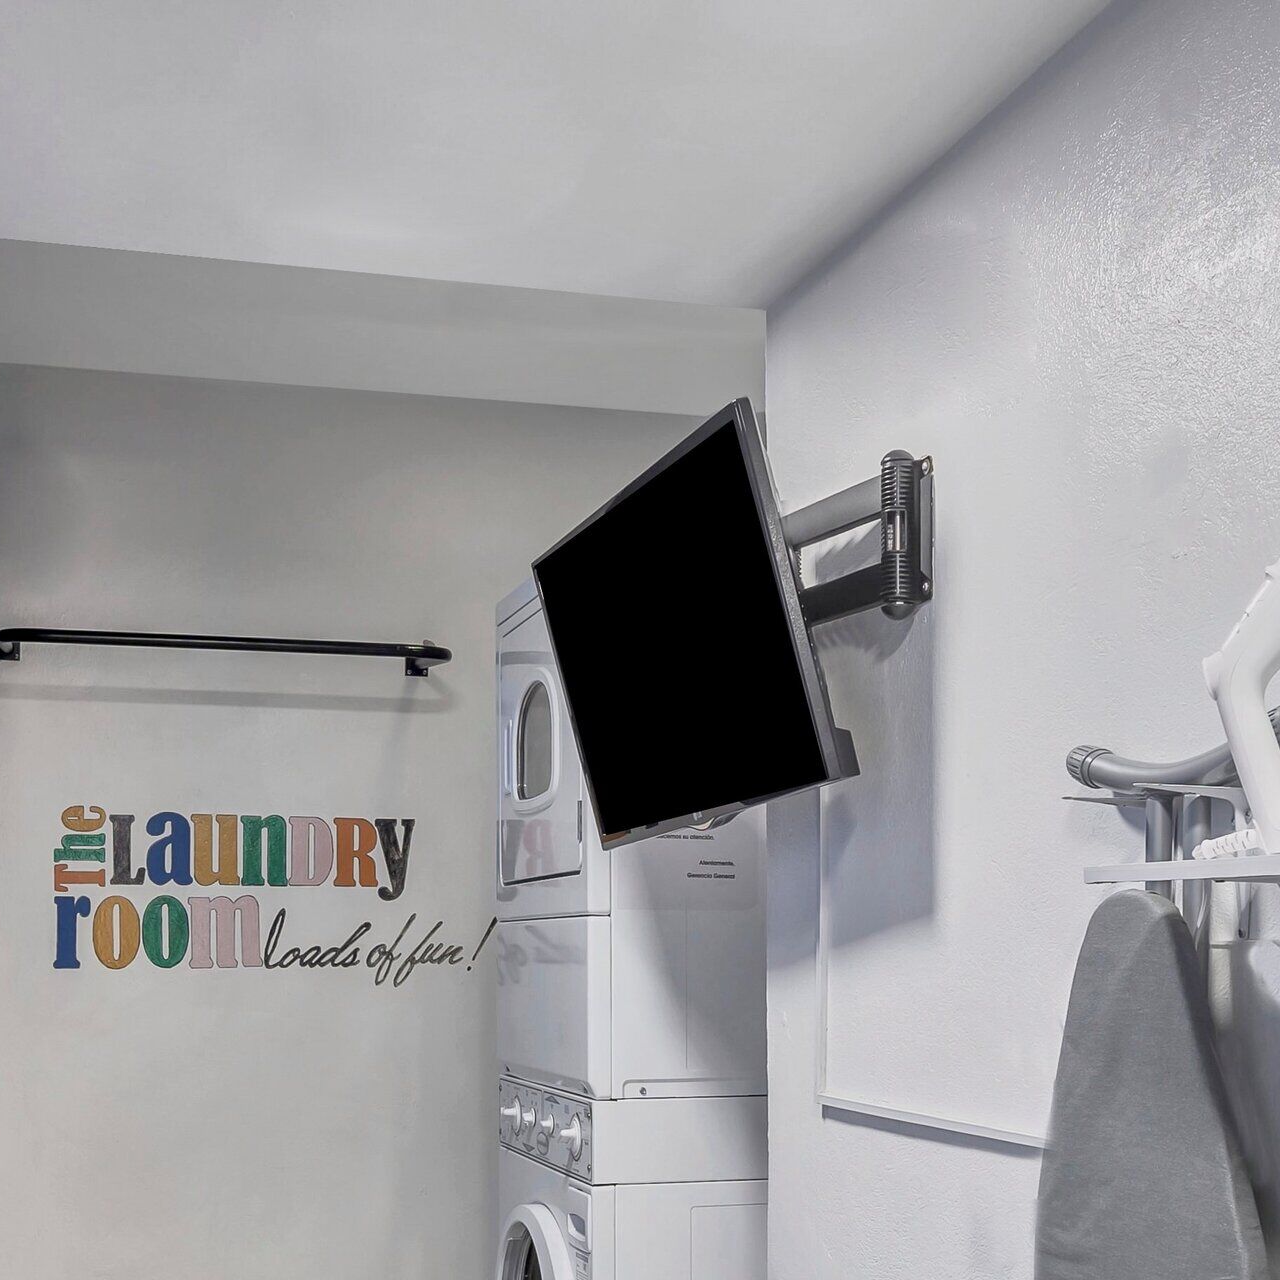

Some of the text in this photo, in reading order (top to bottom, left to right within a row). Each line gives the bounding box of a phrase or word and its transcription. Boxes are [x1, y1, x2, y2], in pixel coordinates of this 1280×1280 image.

[53, 895, 263, 969] room
[263, 908, 372, 969] loads
[366, 912, 417, 987] of
